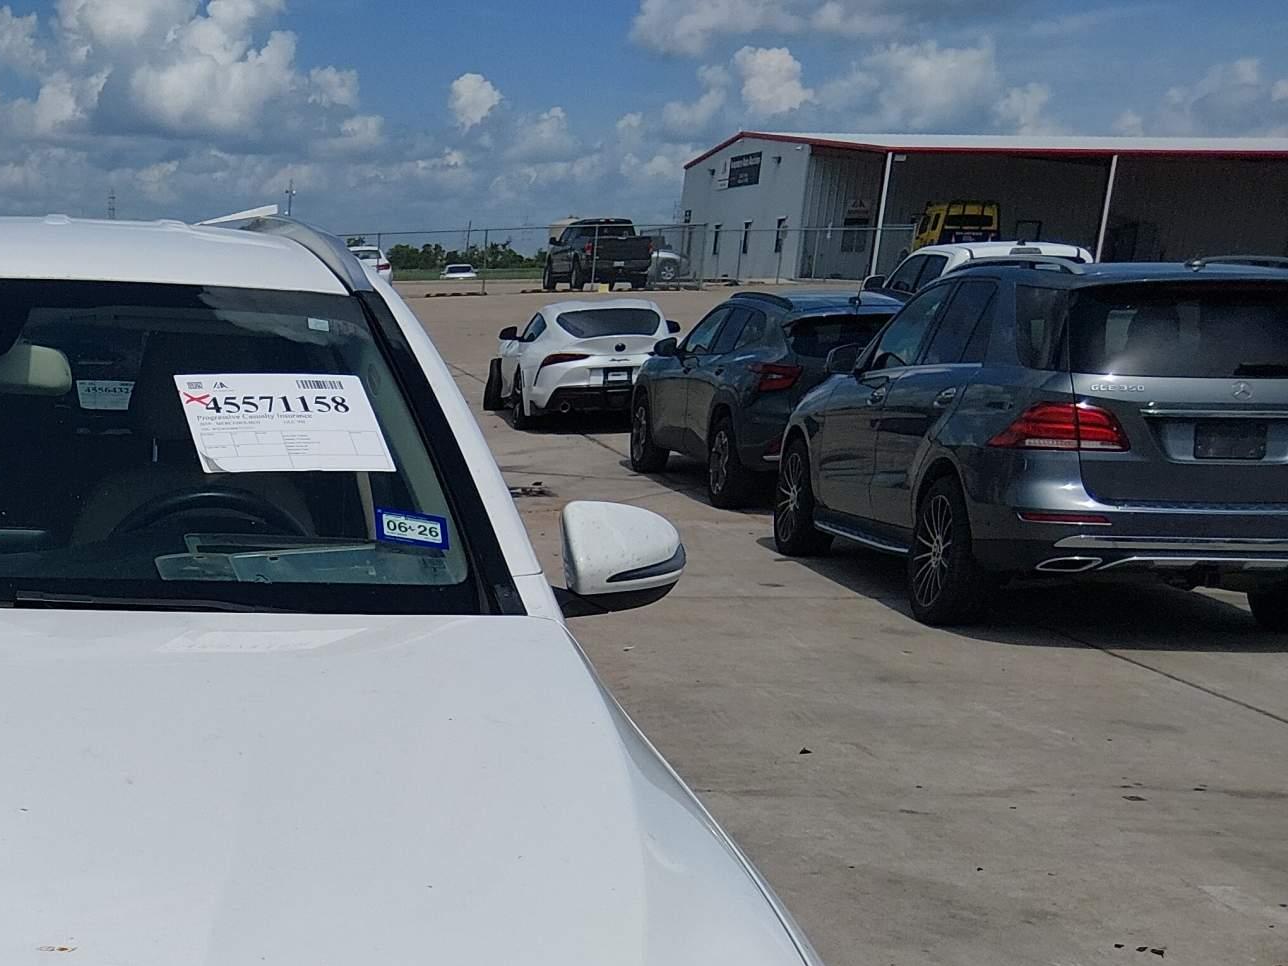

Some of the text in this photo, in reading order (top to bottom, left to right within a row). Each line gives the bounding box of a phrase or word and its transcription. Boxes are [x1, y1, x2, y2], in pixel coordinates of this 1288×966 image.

[205, 395, 350, 414] 45571158
[386, 519, 409, 533] 06
[417, 524, 440, 538] 26
